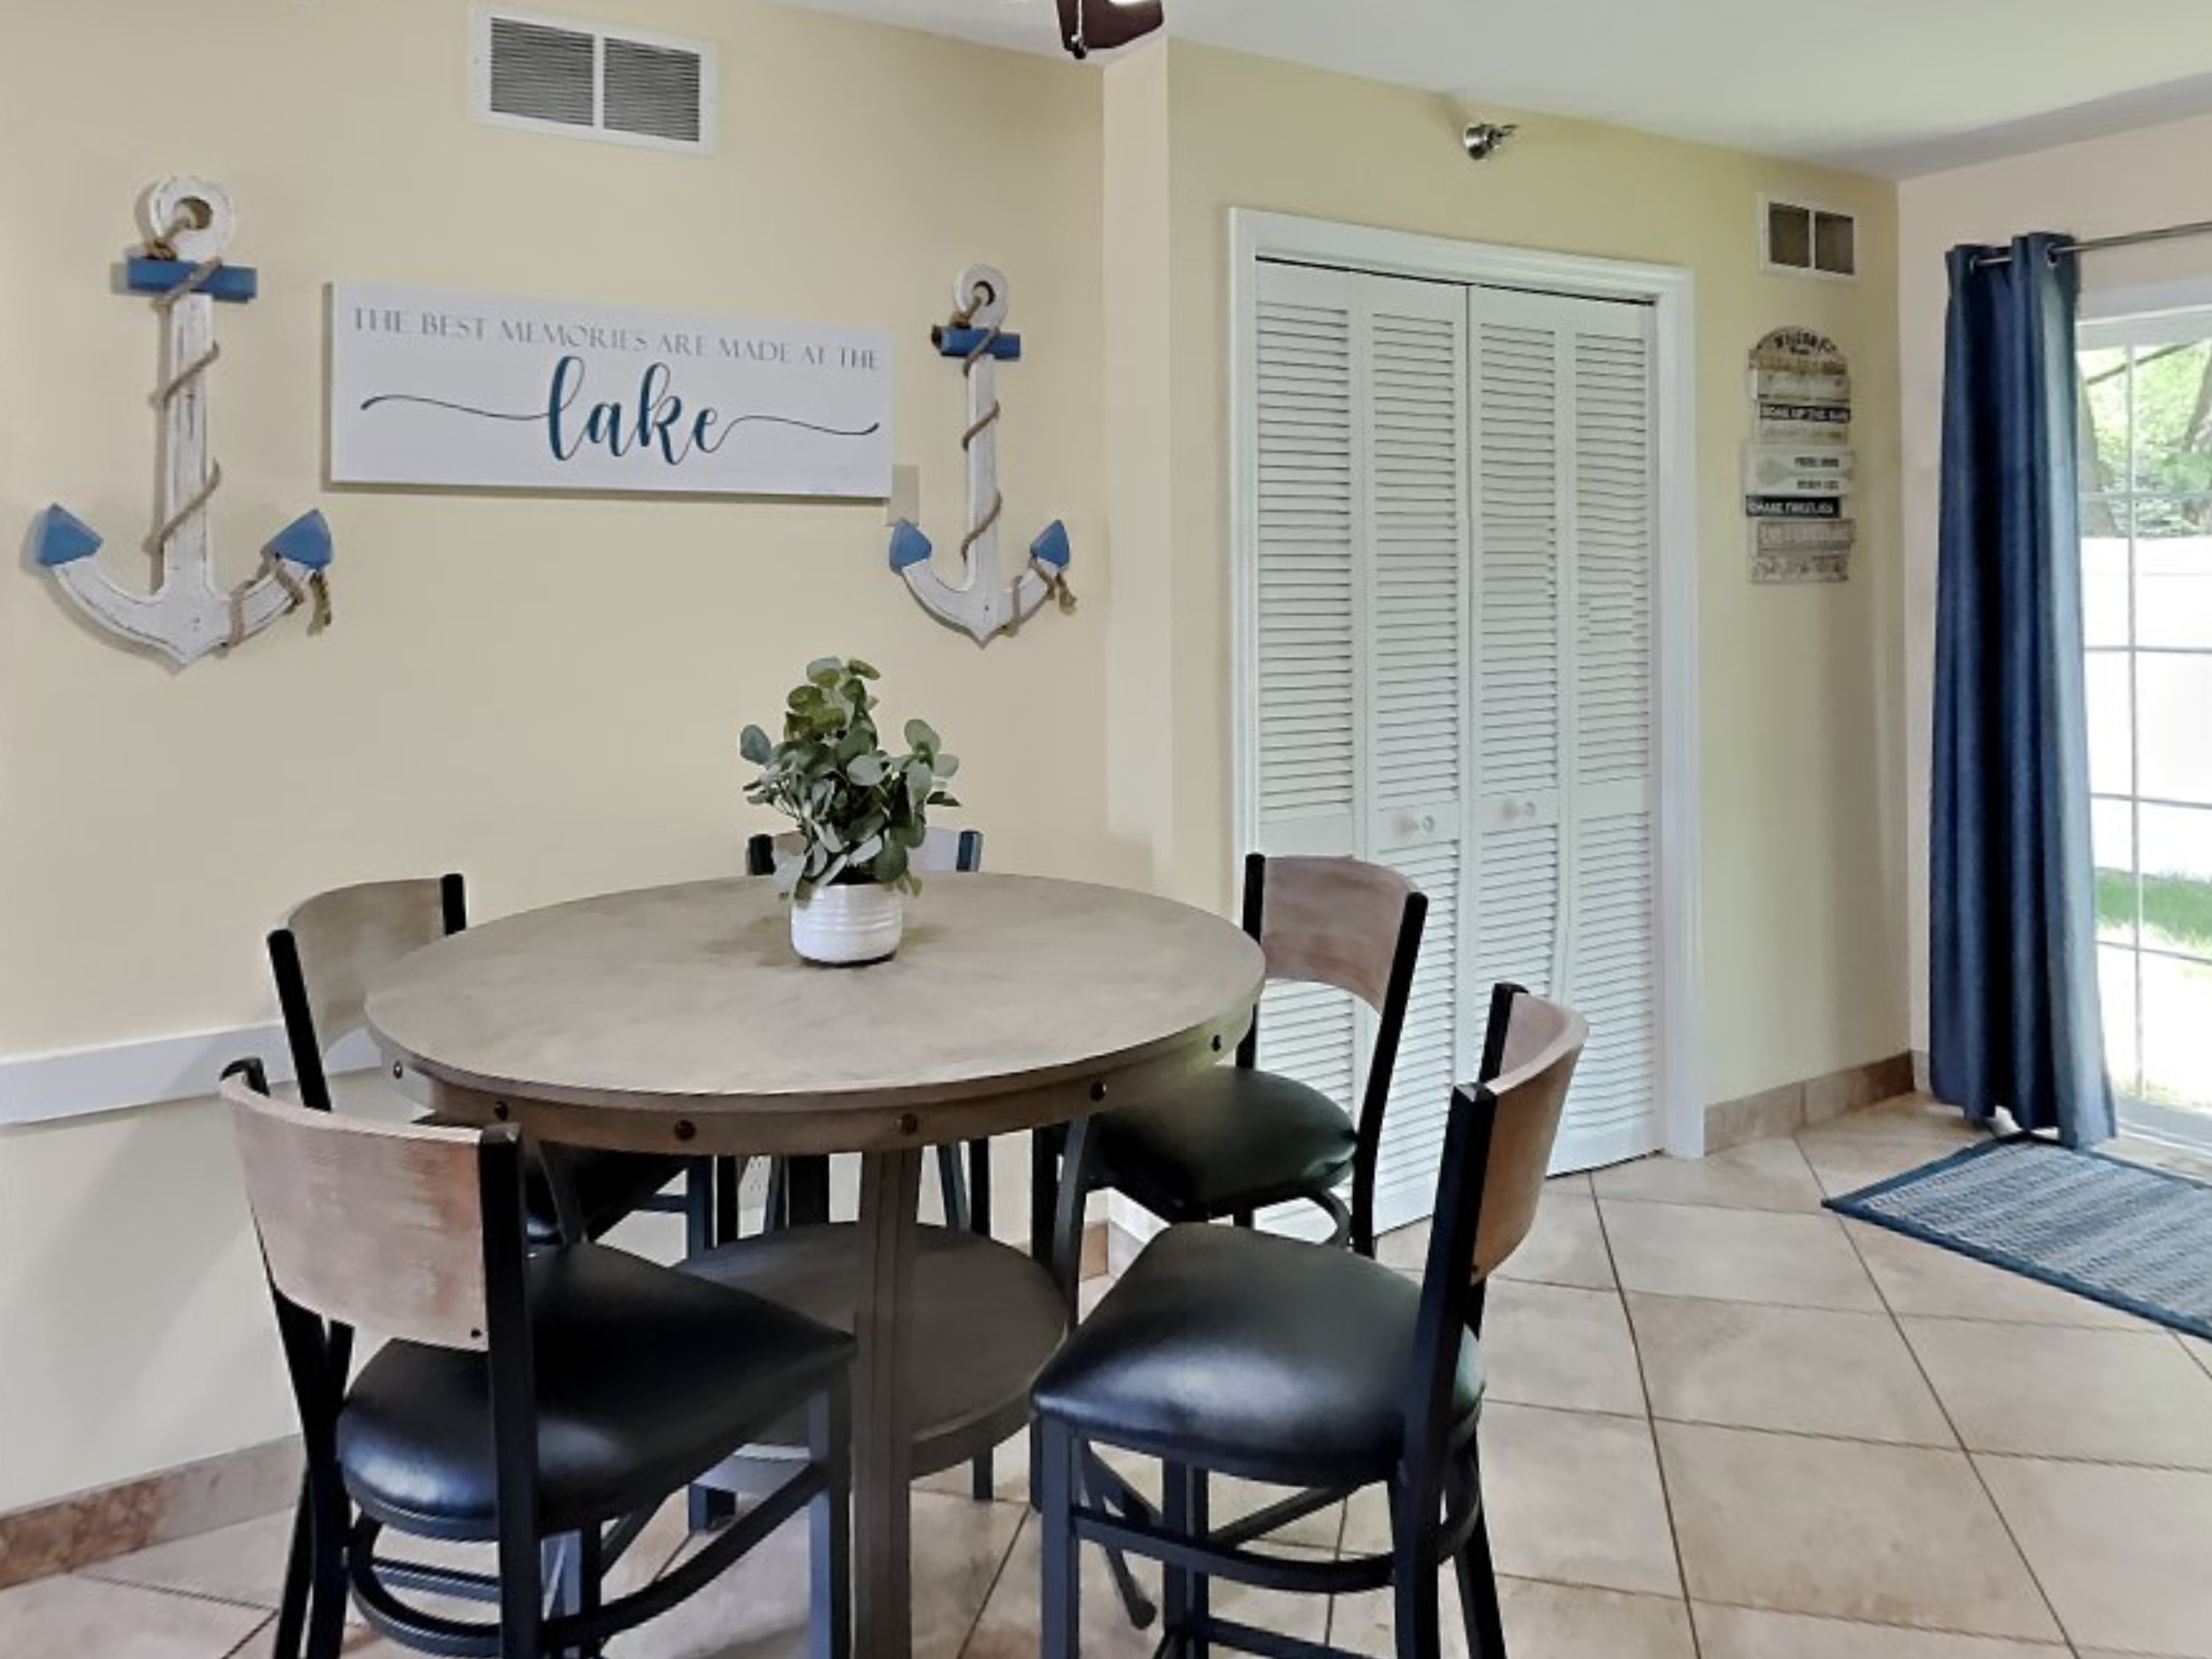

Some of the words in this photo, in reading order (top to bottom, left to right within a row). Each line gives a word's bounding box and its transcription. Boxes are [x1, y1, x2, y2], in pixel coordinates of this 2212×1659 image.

[355, 307, 405, 333] THE
[422, 312, 488, 340] BEST
[501, 319, 647, 352] MEMORIES
[659, 333, 707, 357] ARE
[719, 337, 792, 362] MADE
[801, 344, 826, 365] AT
[838, 347, 878, 369] THE
[548, 355, 719, 465] lake
